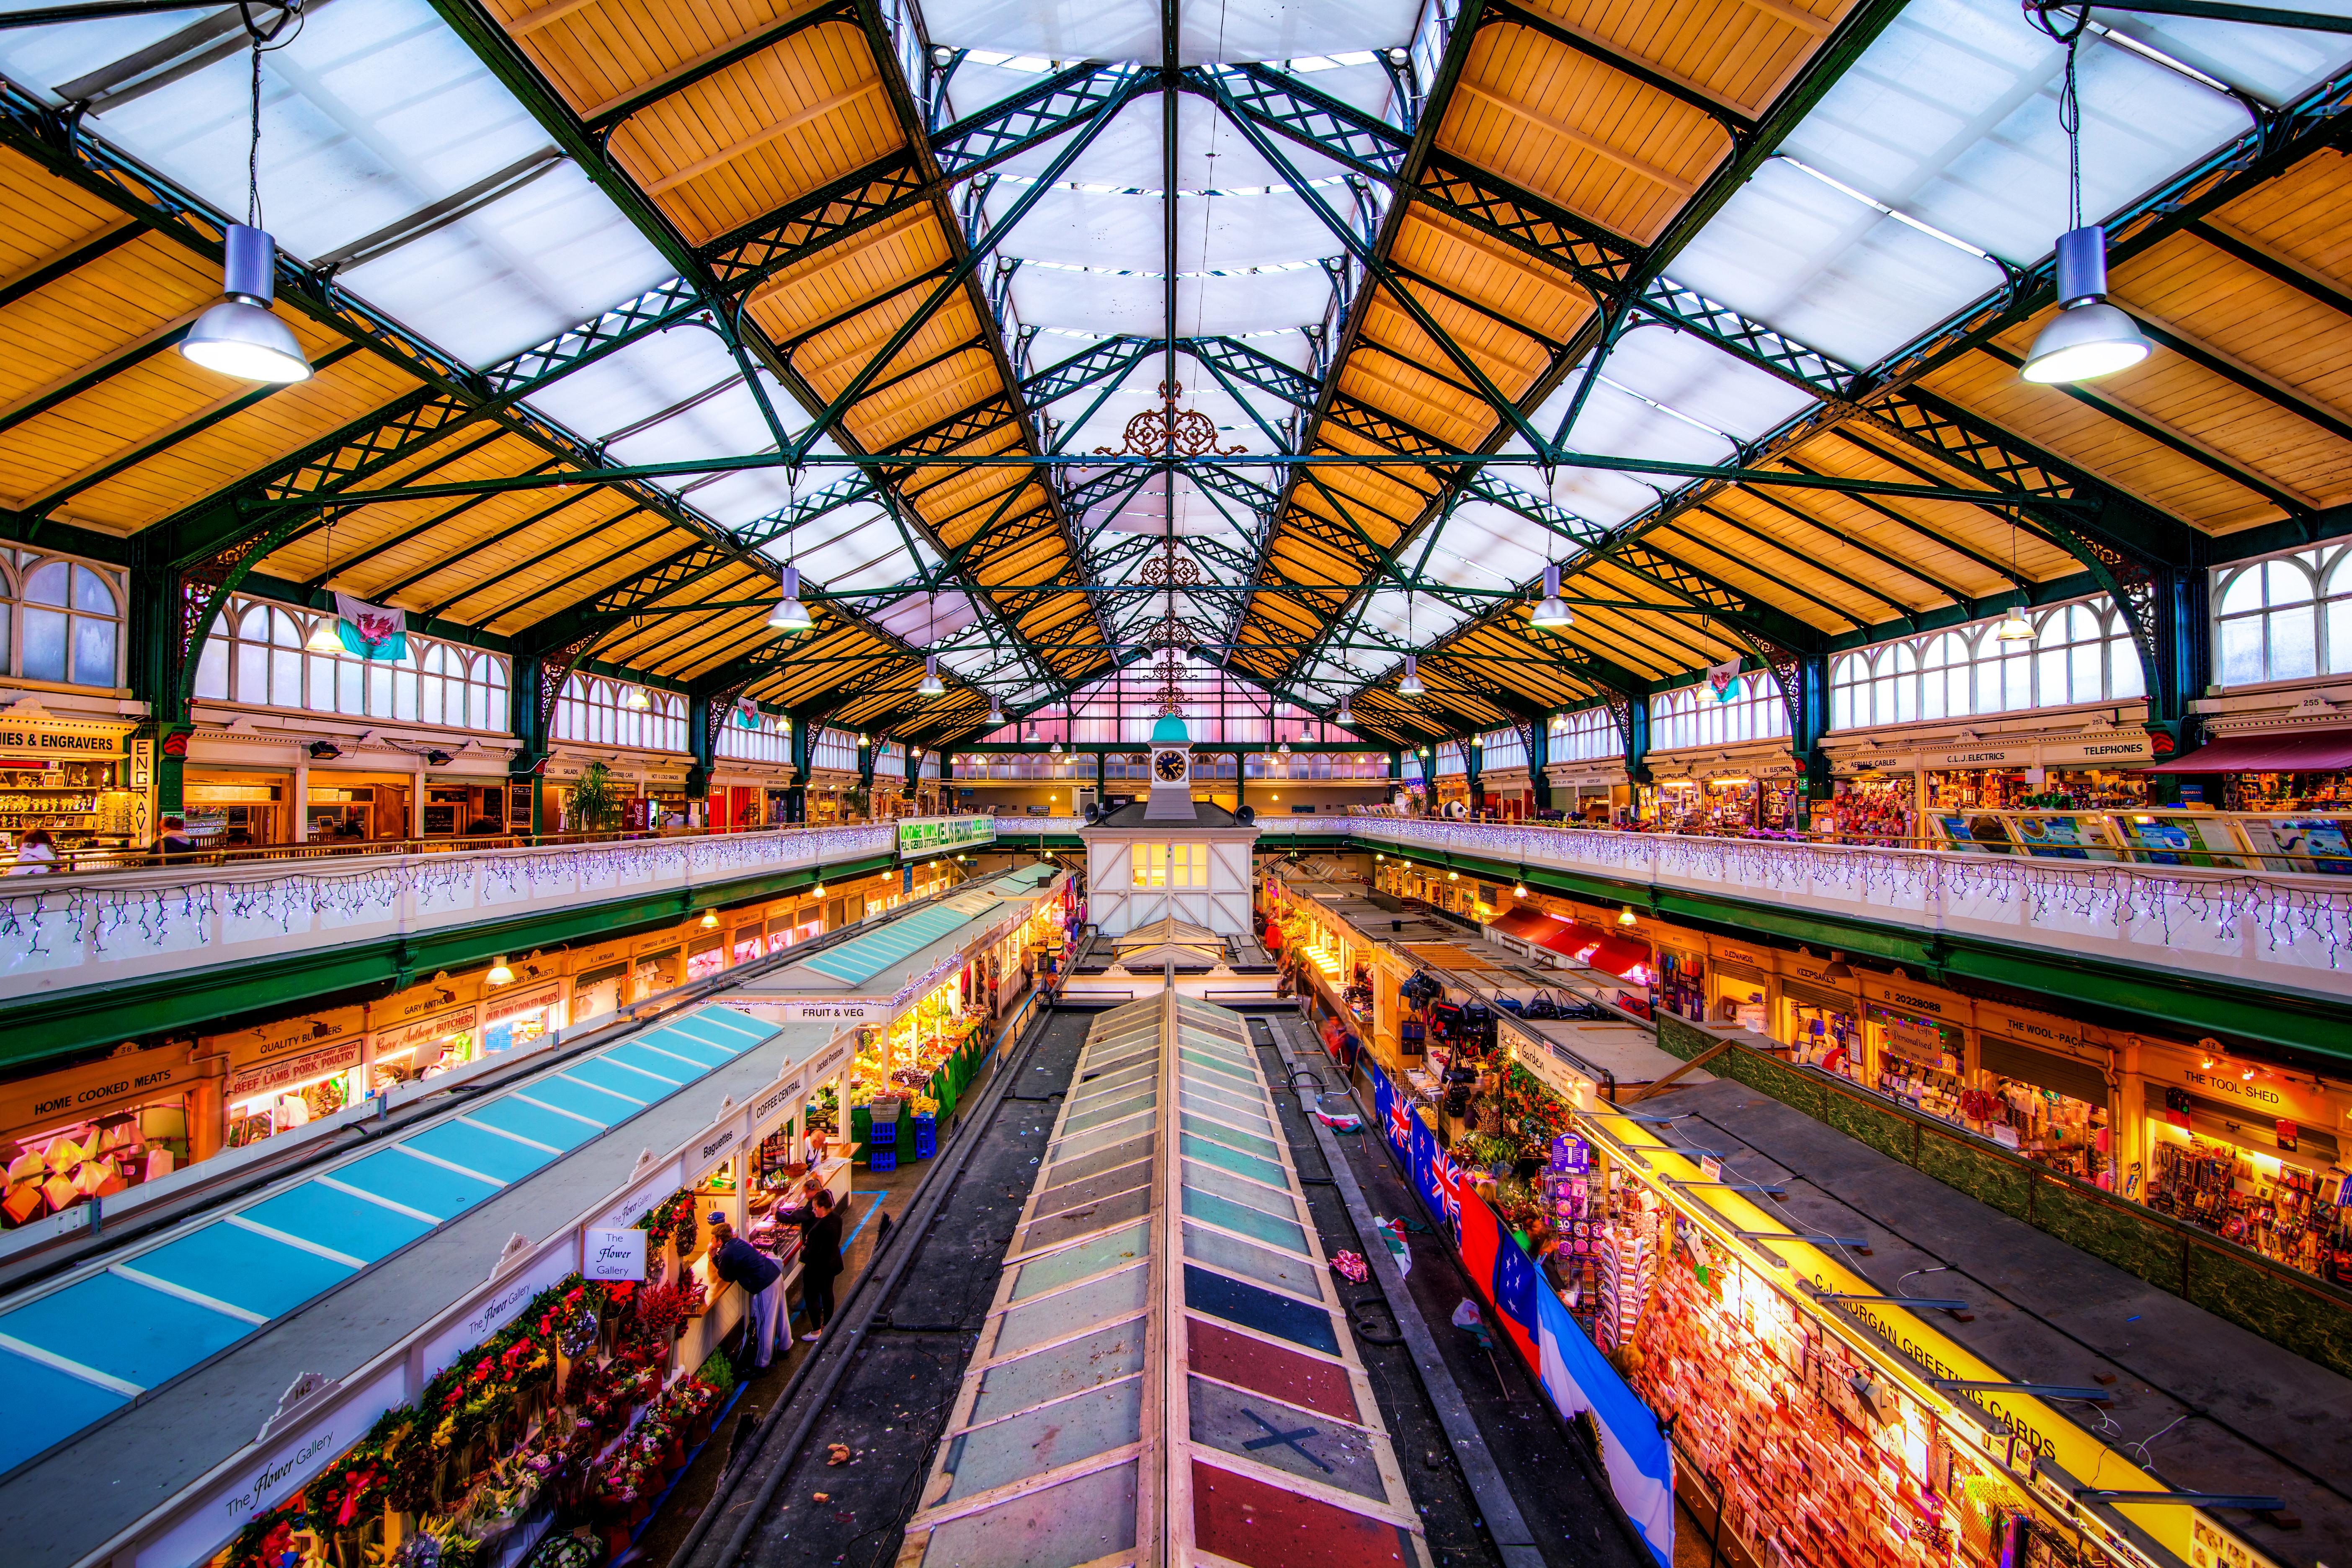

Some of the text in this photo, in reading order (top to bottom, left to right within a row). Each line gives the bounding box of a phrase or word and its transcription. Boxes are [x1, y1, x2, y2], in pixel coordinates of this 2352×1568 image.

[28, 734, 113, 750] & ENGRAVERS
[2084, 744, 2143, 755] TELEPHONES
[923, 823, 937, 838] VINYL
[2020, 830, 2035, 842] GOING
[1634, 926, 1650, 935] SPECIALISTS
[641, 940, 658, 950] COWBRIDGE
[509, 976, 525, 986] MEATS
[1797, 967, 1836, 984] KEEPSAKES
[405, 998, 446, 1015] GARY ANTHO
[486, 991, 557, 1021] OUR OWN COOKED MEATS
[1895, 993, 1941, 1013] 20228088
[803, 1008, 864, 1017] FRUIT & VEG
[436, 1013, 474, 1034] BUTCHERS
[1917, 1026, 1932, 1037] Gifts
[260, 1025, 342, 1054] QUALITY BUERS
[376, 1025, 436, 1055] Gary Anthony
[1892, 1029, 1932, 1051] Personalised
[2007, 1019, 2084, 1048] THE WOOL-PACK
[121, 1045, 132, 1054] 36
[313, 1049, 336, 1060] DELIVERY
[1522, 1044, 1545, 1073] Garden
[1893, 1044, 1935, 1065] While you wait
[816, 1047, 844, 1073] Jacket Potatoes
[234, 1050, 356, 1095] BEEF LAMB PORK POULTRY
[237, 1063, 292, 1083] Finest Quality
[273, 1078, 297, 1089] FREEZE
[301, 1066, 336, 1081] SPECIALISTS
[35, 1069, 171, 1116] HOME COOKED MEATS
[2184, 1070, 2279, 1104] THE TOOL SHED
[757, 1079, 800, 1119] COFFEE CENTRAL
[704, 1130, 732, 1159] Baguettes
[1703, 1158, 1719, 1170] FRAGILE
[1704, 1167, 1716, 1178] ROOF
[1558, 1184, 1570, 1197] 30
[612, 1191, 652, 1226] The Flower Gallery
[606, 1233, 623, 1242] The
[1575, 1225, 1588, 1234] 50
[511, 1240, 521, 1252] 140
[596, 1245, 631, 1263] Flower
[1576, 1241, 1586, 1251] 70
[597, 1266, 629, 1277] Gallery
[469, 1283, 531, 1335] The Flower Gallery
[294, 1381, 312, 1400] 142
[1991, 1400, 2056, 1460] CARDS
[226, 1431, 333, 1517] The Flower Gallery
